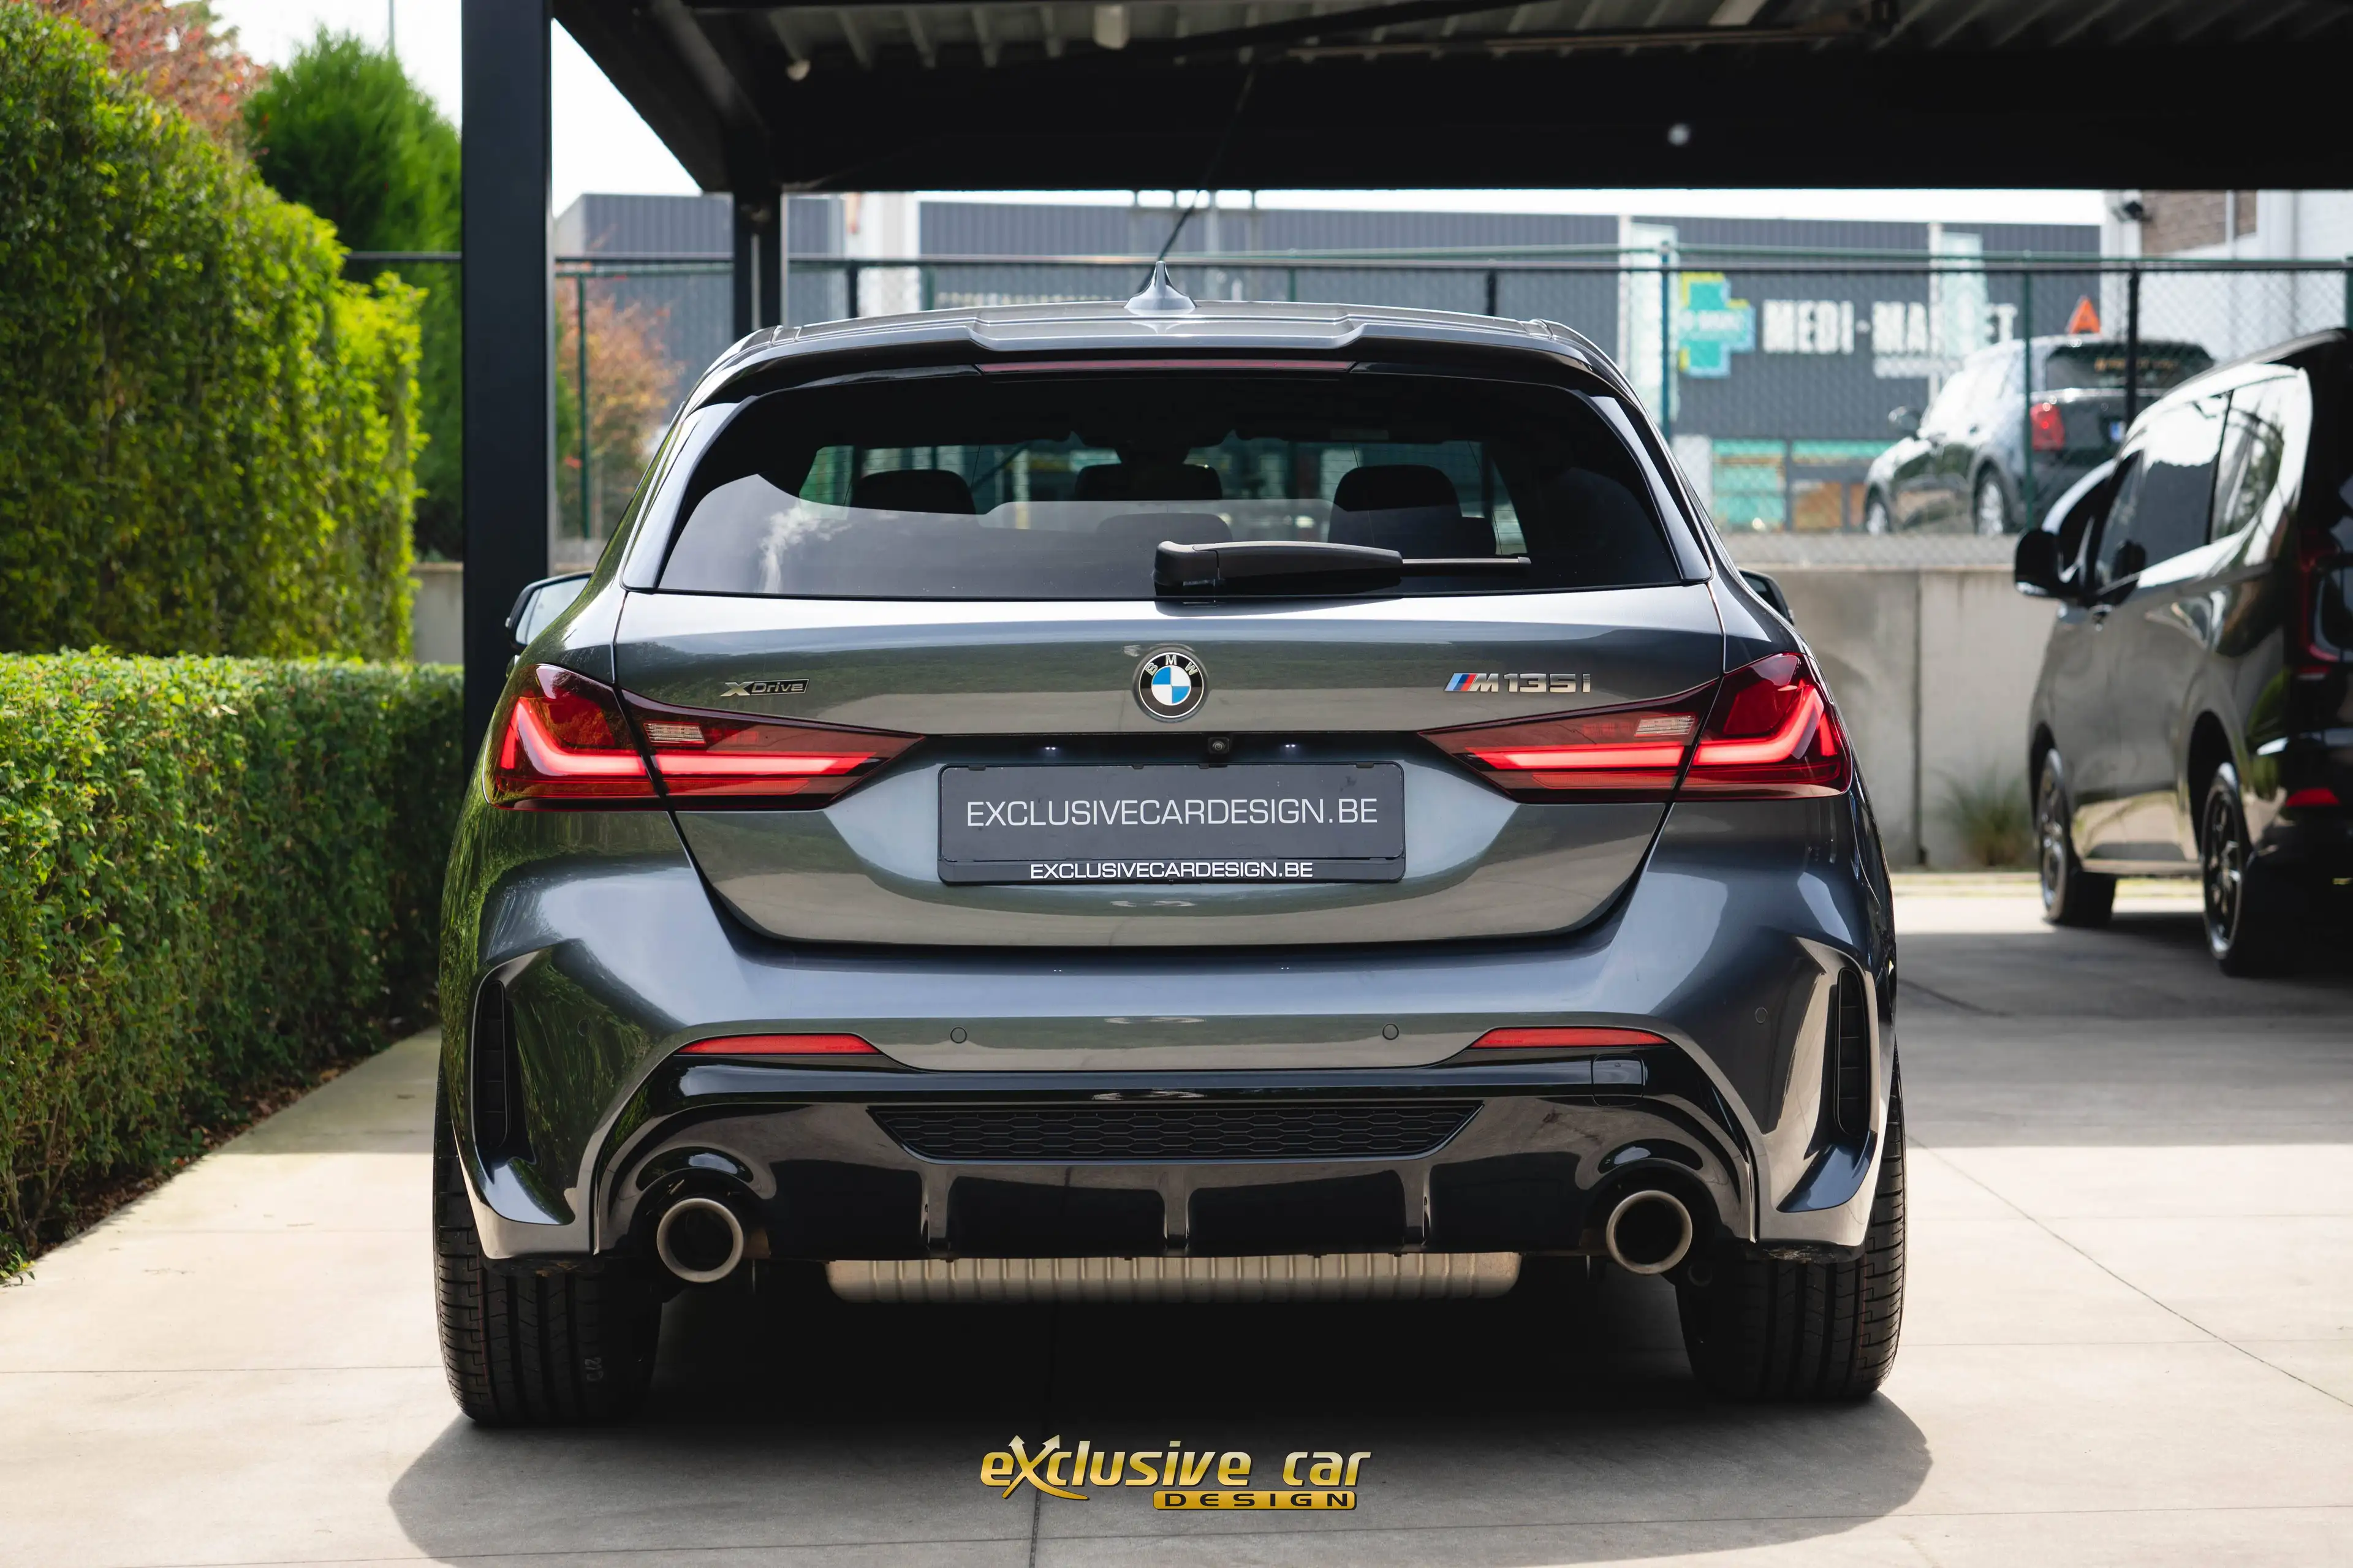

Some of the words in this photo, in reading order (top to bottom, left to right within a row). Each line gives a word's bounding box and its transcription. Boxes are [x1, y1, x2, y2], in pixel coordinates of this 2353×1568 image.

[1145, 654, 1199, 676] BMW
[1468, 673, 1591, 693] M135i
[968, 798, 1377, 827] EXCLUSIVECARDESIGN.BE
[1031, 862, 1313, 879] EXCLUSIVECARDESIGN.BE
